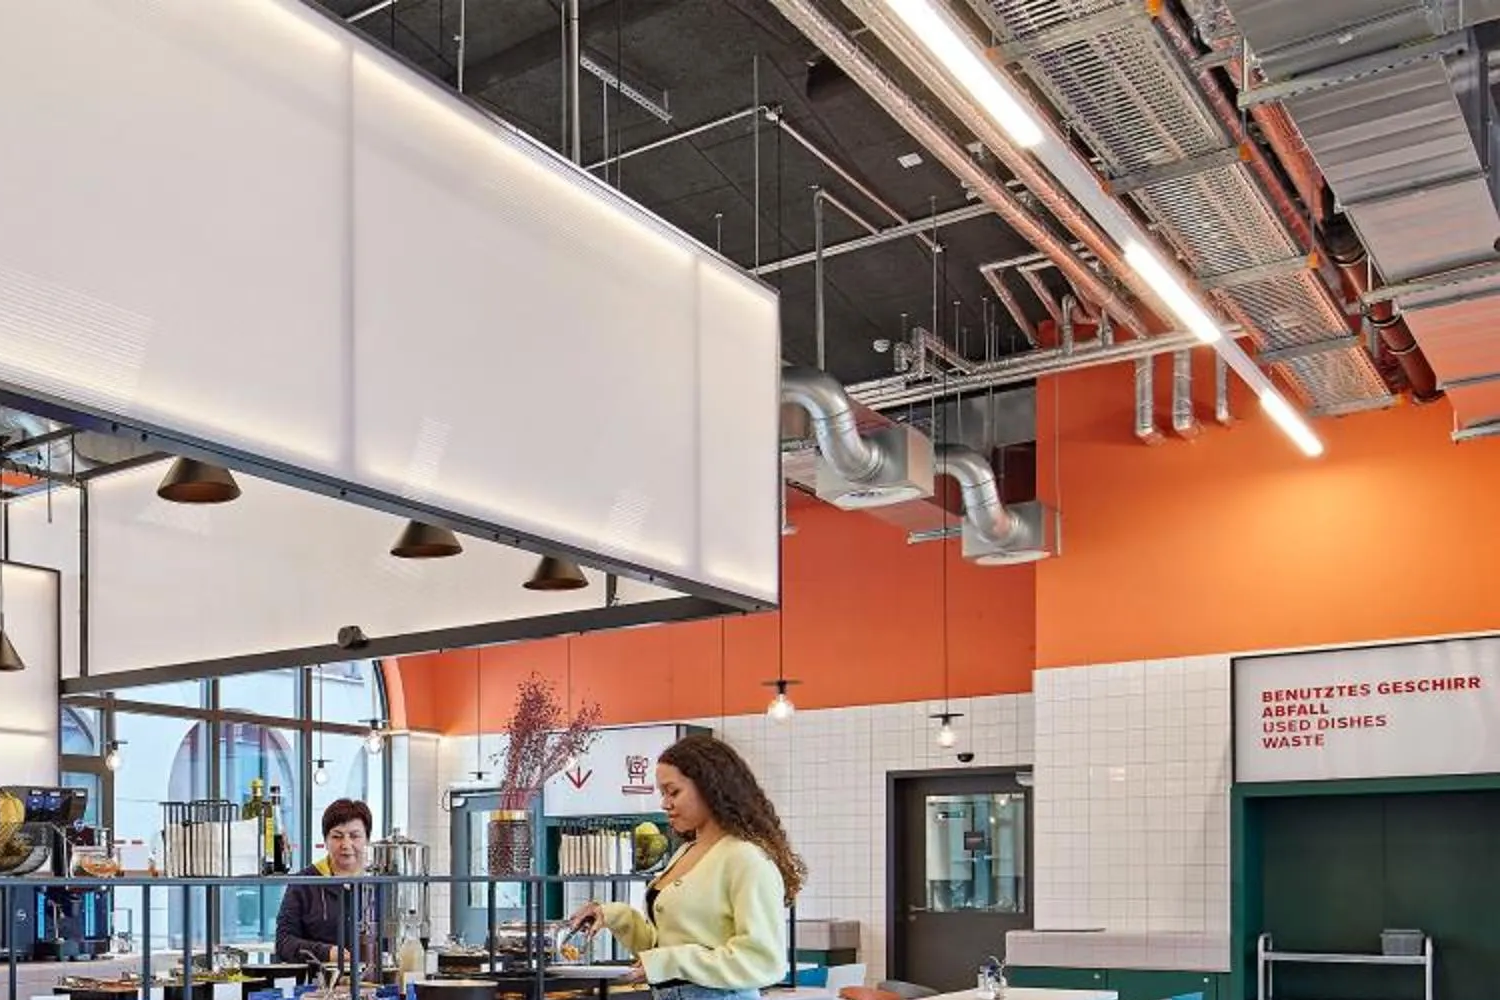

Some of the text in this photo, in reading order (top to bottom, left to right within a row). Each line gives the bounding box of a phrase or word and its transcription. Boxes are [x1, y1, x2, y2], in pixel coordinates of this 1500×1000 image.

[1262, 676, 1481, 703] BENUTZTES GESCHIRR
[1262, 703, 1329, 718] ABFALL
[1263, 715, 1387, 733] USED DISHES
[1263, 733, 1325, 749] WASTE
